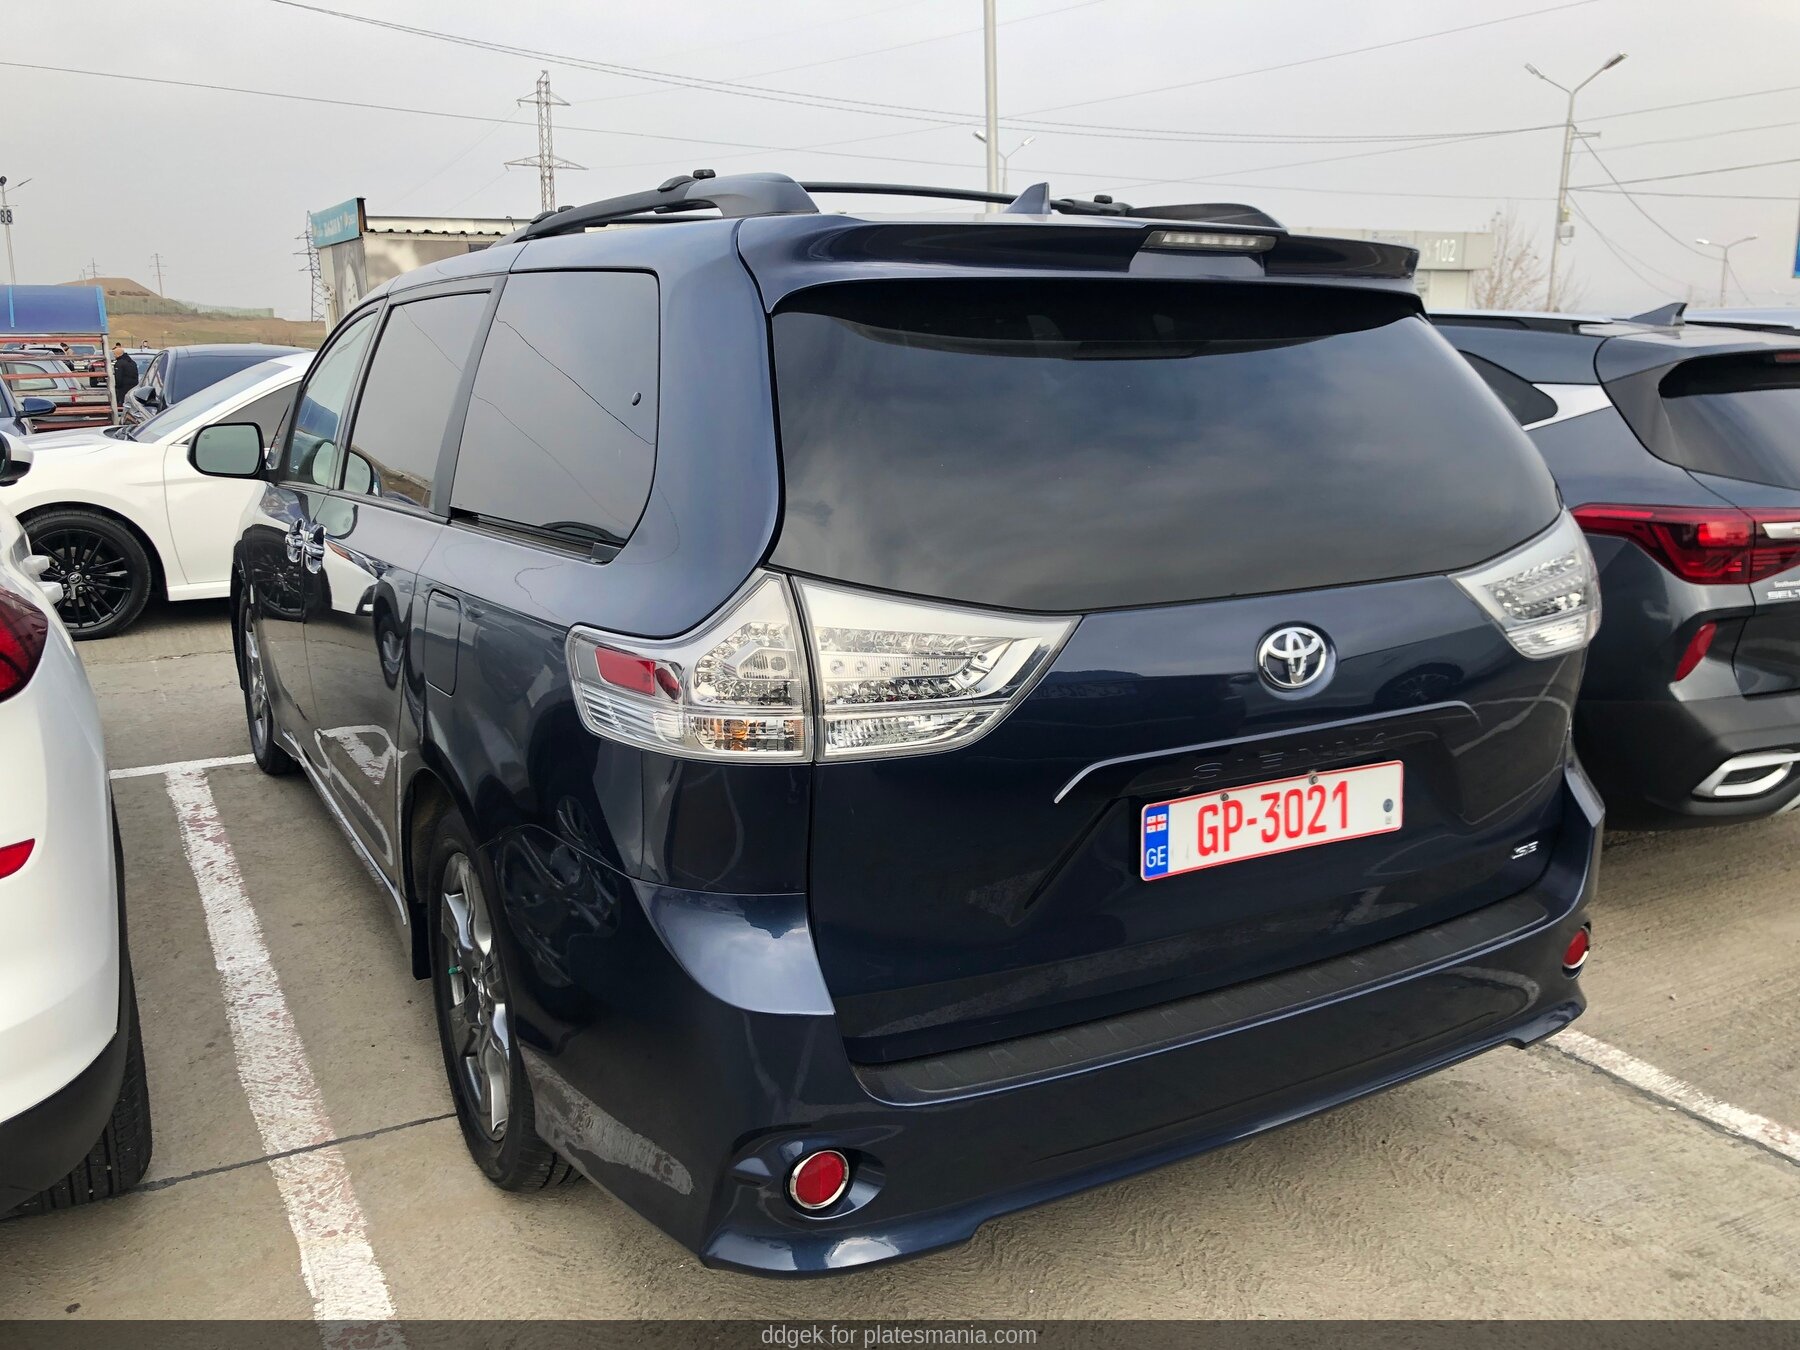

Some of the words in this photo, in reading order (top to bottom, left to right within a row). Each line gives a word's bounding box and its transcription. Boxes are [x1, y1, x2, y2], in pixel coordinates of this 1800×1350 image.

[1197, 780, 1348, 857] GP-3021
[1145, 846, 1167, 868] GE
[1511, 840, 1539, 860] SE
